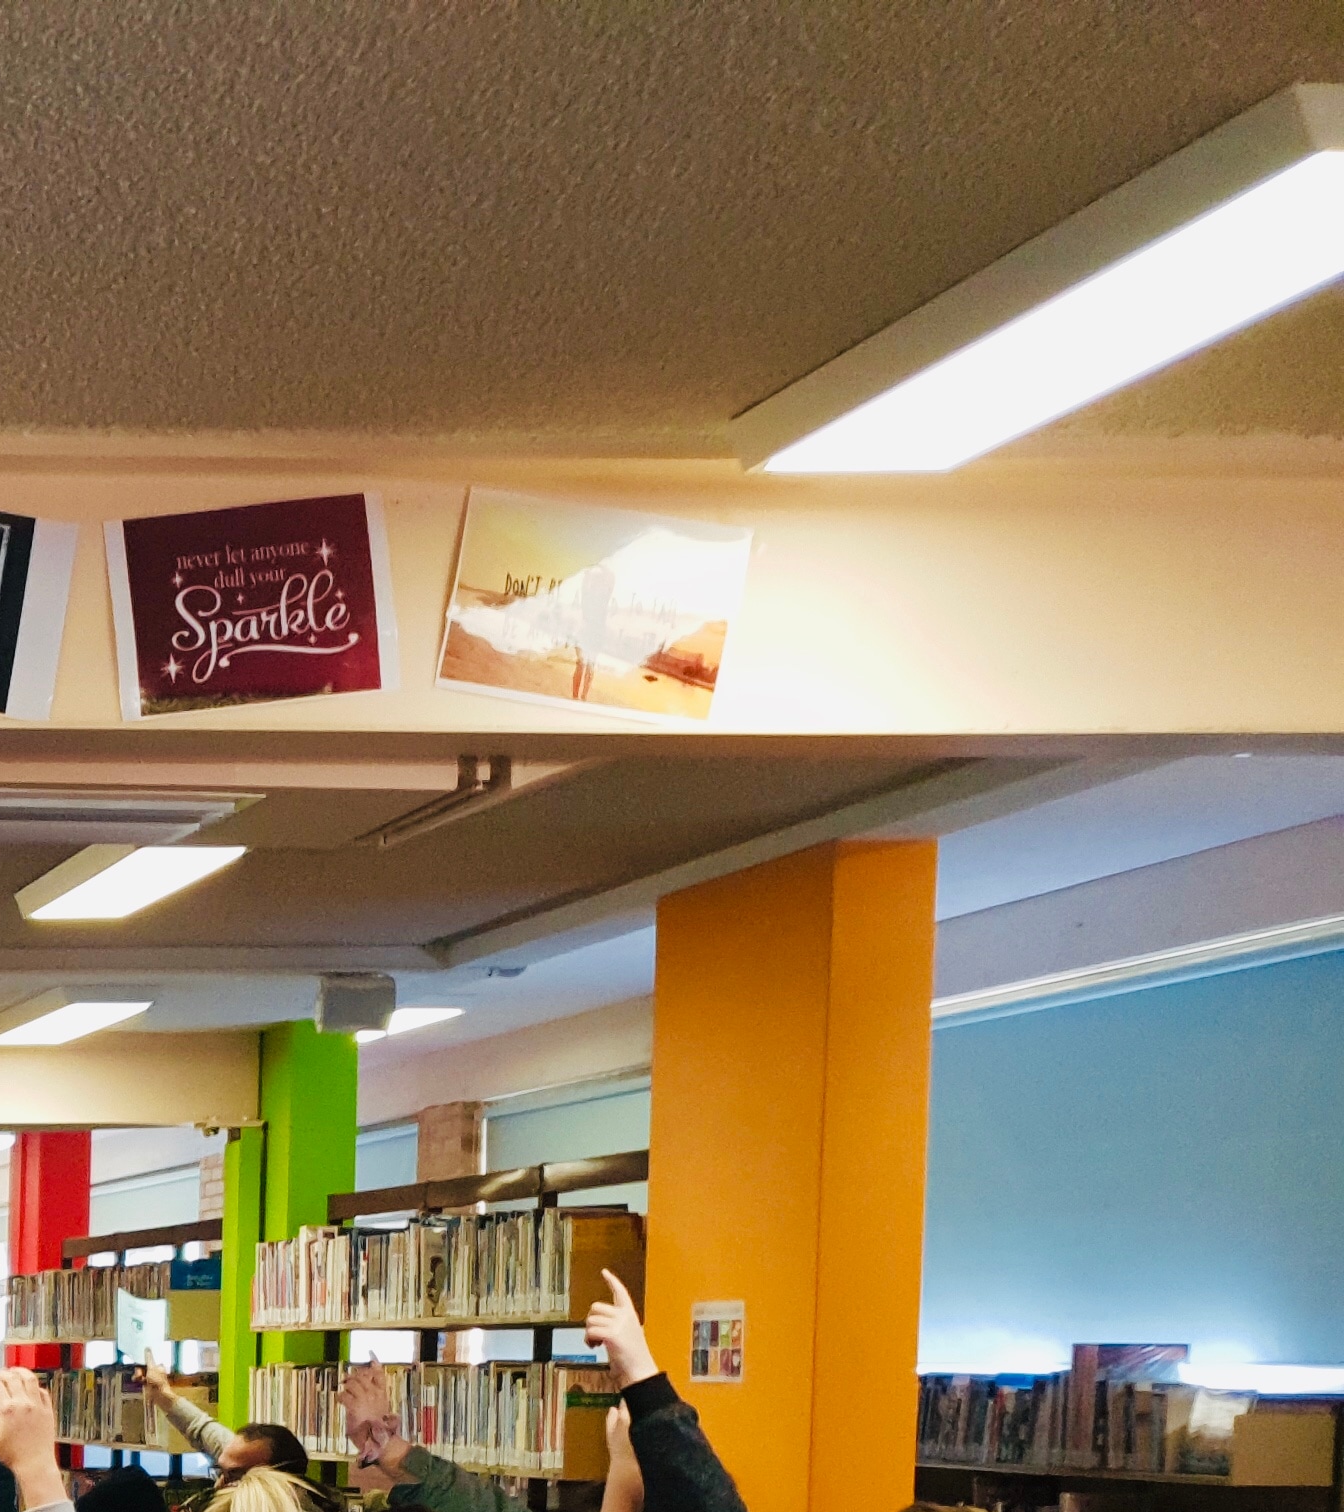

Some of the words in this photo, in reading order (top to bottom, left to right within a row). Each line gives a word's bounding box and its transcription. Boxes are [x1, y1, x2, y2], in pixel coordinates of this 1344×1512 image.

[175, 550, 221, 569] never
[224, 543, 246, 564] let
[250, 541, 309, 564] anyone
[213, 565, 245, 589] dull
[247, 567, 286, 587] your
[503, 571, 542, 598] DON'T
[171, 569, 350, 683] Sparkle
